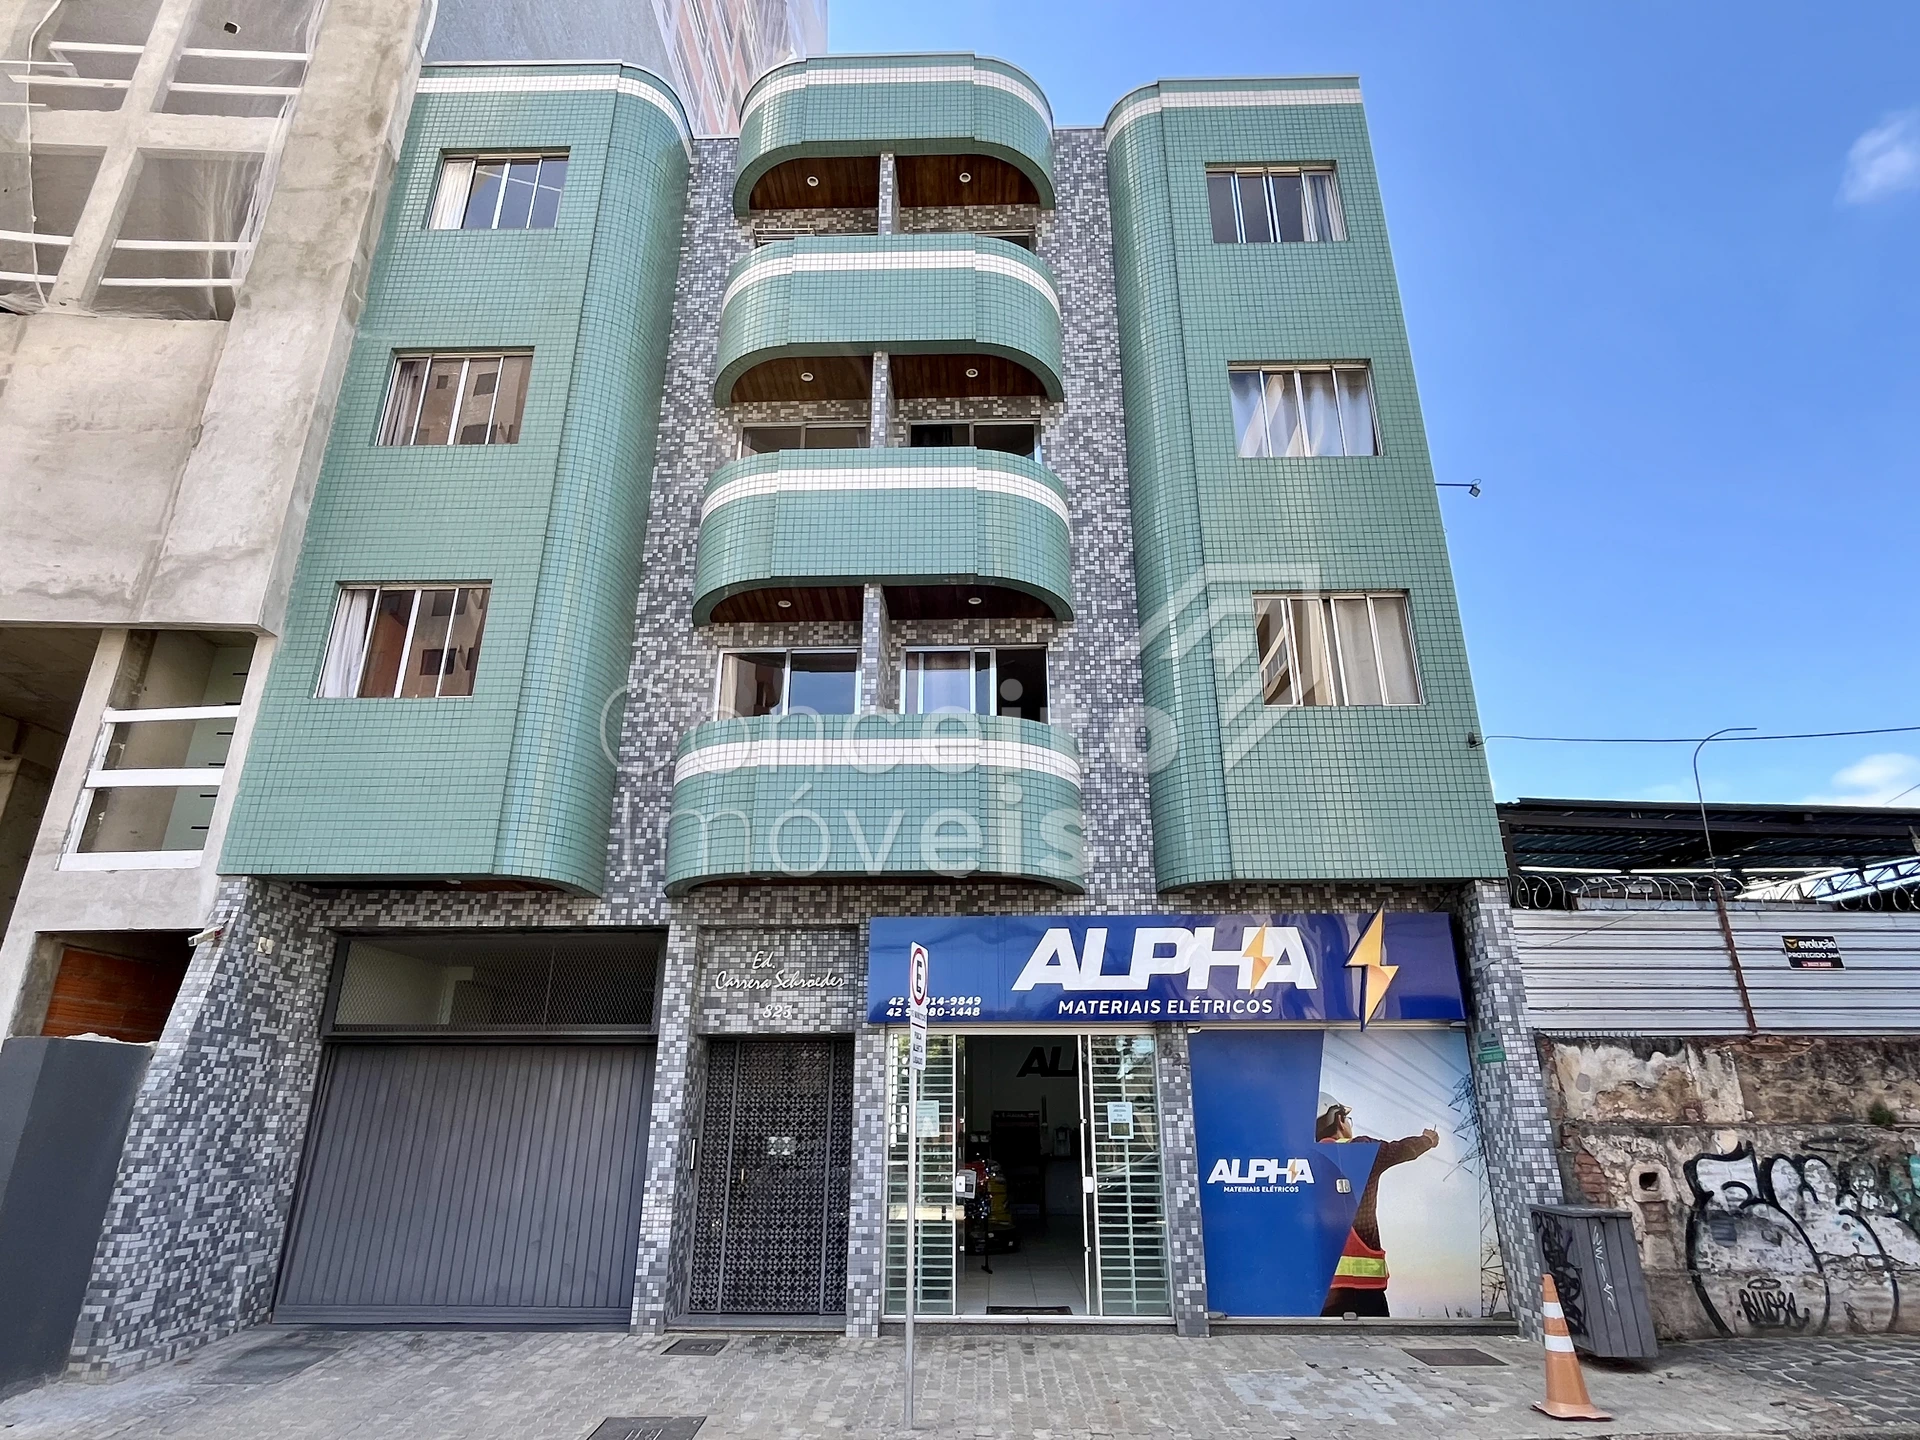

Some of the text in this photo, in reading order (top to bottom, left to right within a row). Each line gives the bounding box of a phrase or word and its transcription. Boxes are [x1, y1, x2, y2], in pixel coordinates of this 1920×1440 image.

[1798, 939, 1836, 949] evolução
[752, 950, 776, 969] Ed.
[1011, 926, 1317, 991] ALPHA
[715, 970, 770, 990] Carrera
[888, 996, 904, 1006] 42
[1058, 996, 1274, 1015] MATERIAIS ELÉTRICOS
[762, 1003, 794, 1019] 823
[886, 1007, 902, 1017] 42
[1016, 1046, 1079, 1078] AL
[1207, 1158, 1315, 1184] ALPHA
[1261, 1184, 1299, 1193] ELÉTRICOS
